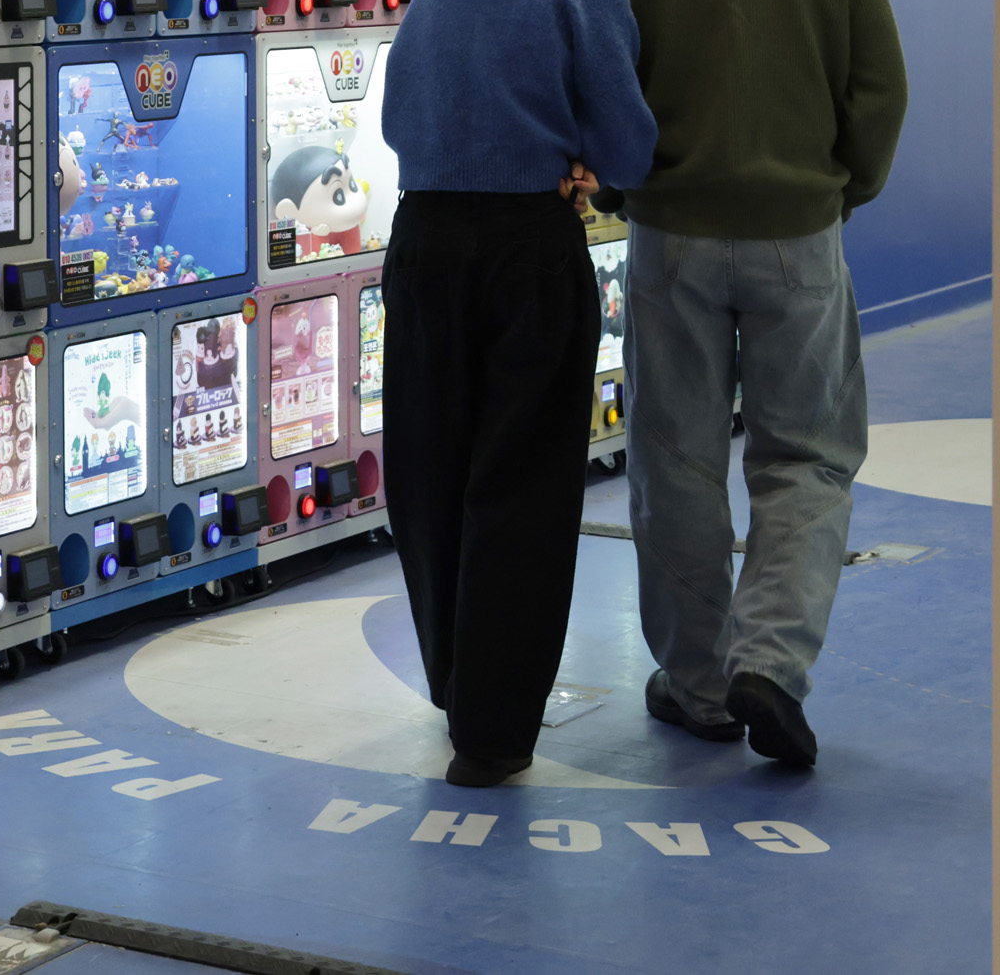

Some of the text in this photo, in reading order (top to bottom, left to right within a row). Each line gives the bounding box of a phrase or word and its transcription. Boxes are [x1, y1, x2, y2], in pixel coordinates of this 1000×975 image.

[335, 77, 359, 91] CUBE
[142, 93, 171, 109] CUBE
[62, 255, 70, 264] 010
[196, 387, 233, 406] ブルーロック
[306, 799, 832, 856] GACHA
